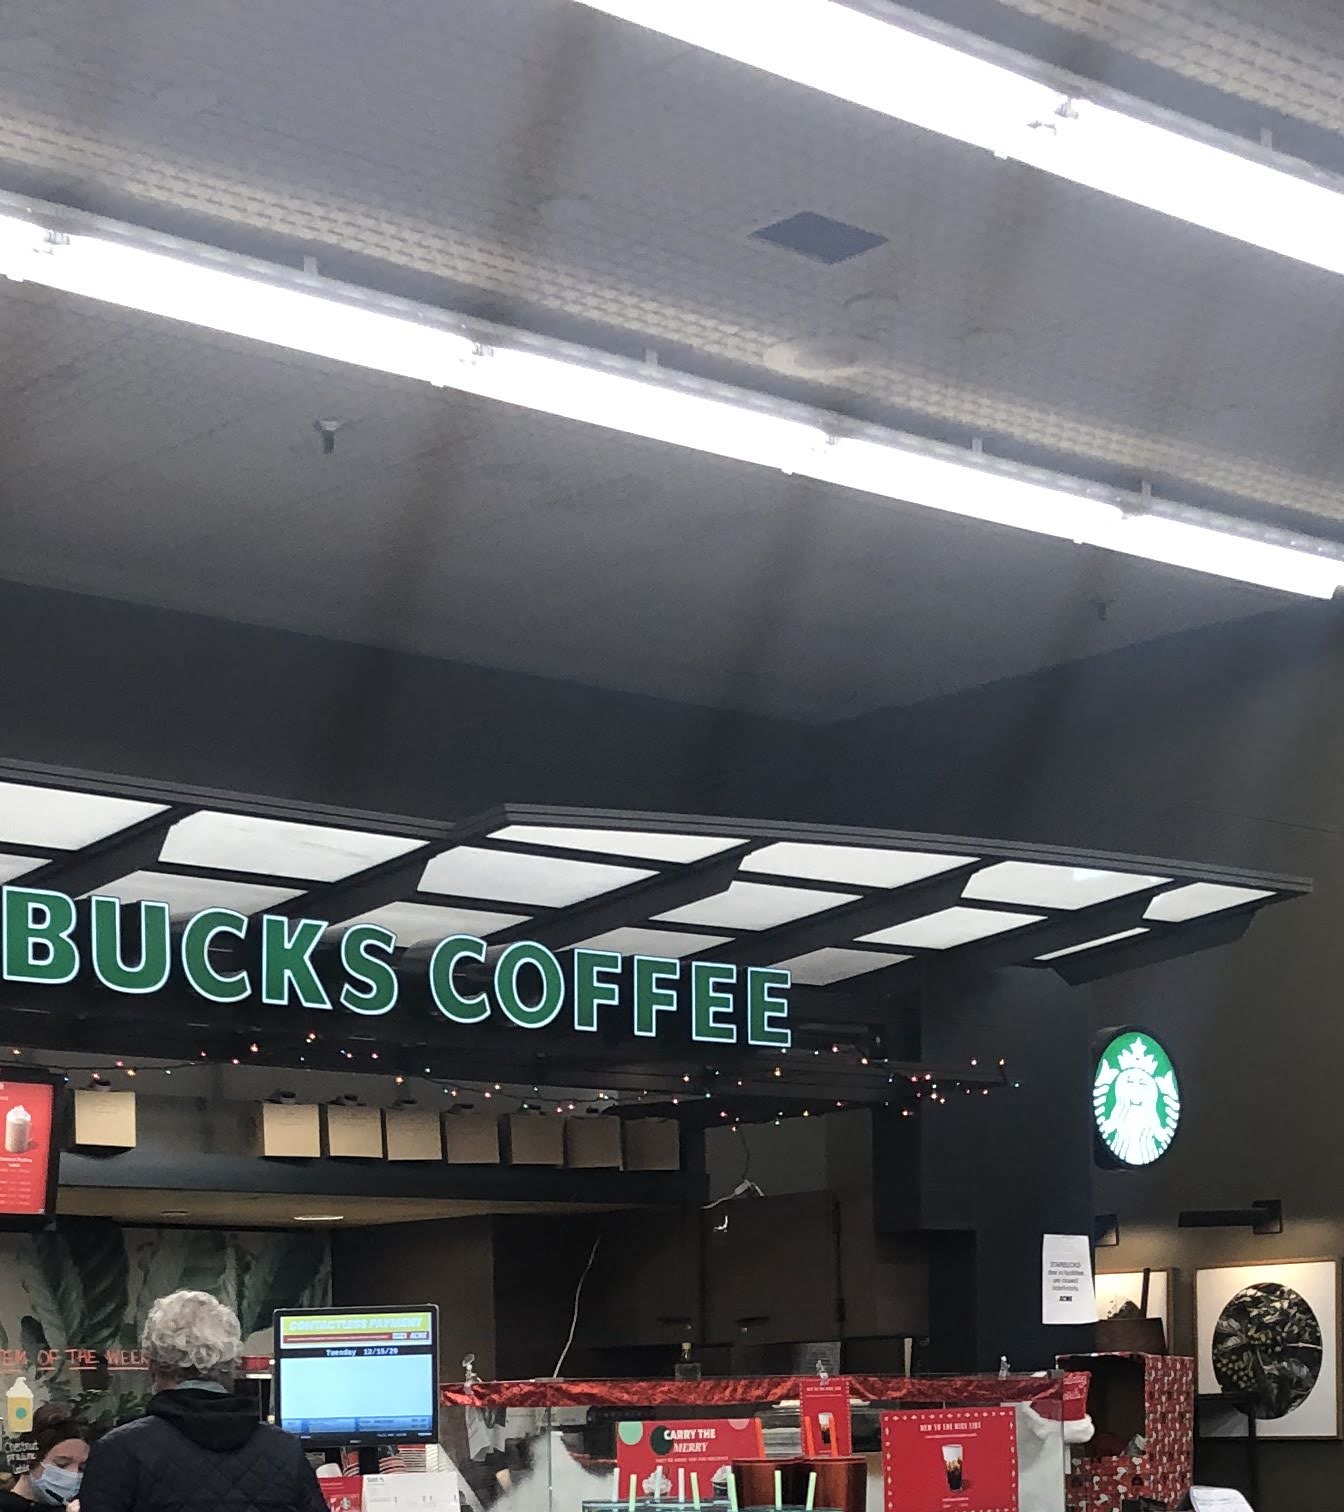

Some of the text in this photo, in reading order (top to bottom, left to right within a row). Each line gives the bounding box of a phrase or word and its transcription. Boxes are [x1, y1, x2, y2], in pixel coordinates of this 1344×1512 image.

[429, 934, 792, 1047] COFFEE
[290, 1317, 423, 1331] CONTACTLESS PAYMENT
[37, 1349, 58, 1366] OF
[65, 1349, 99, 1364] THE
[326, 1349, 356, 1357] Tuesday
[663, 1428, 716, 1441] CARRY THE
[673, 1442, 709, 1453] MERRY
